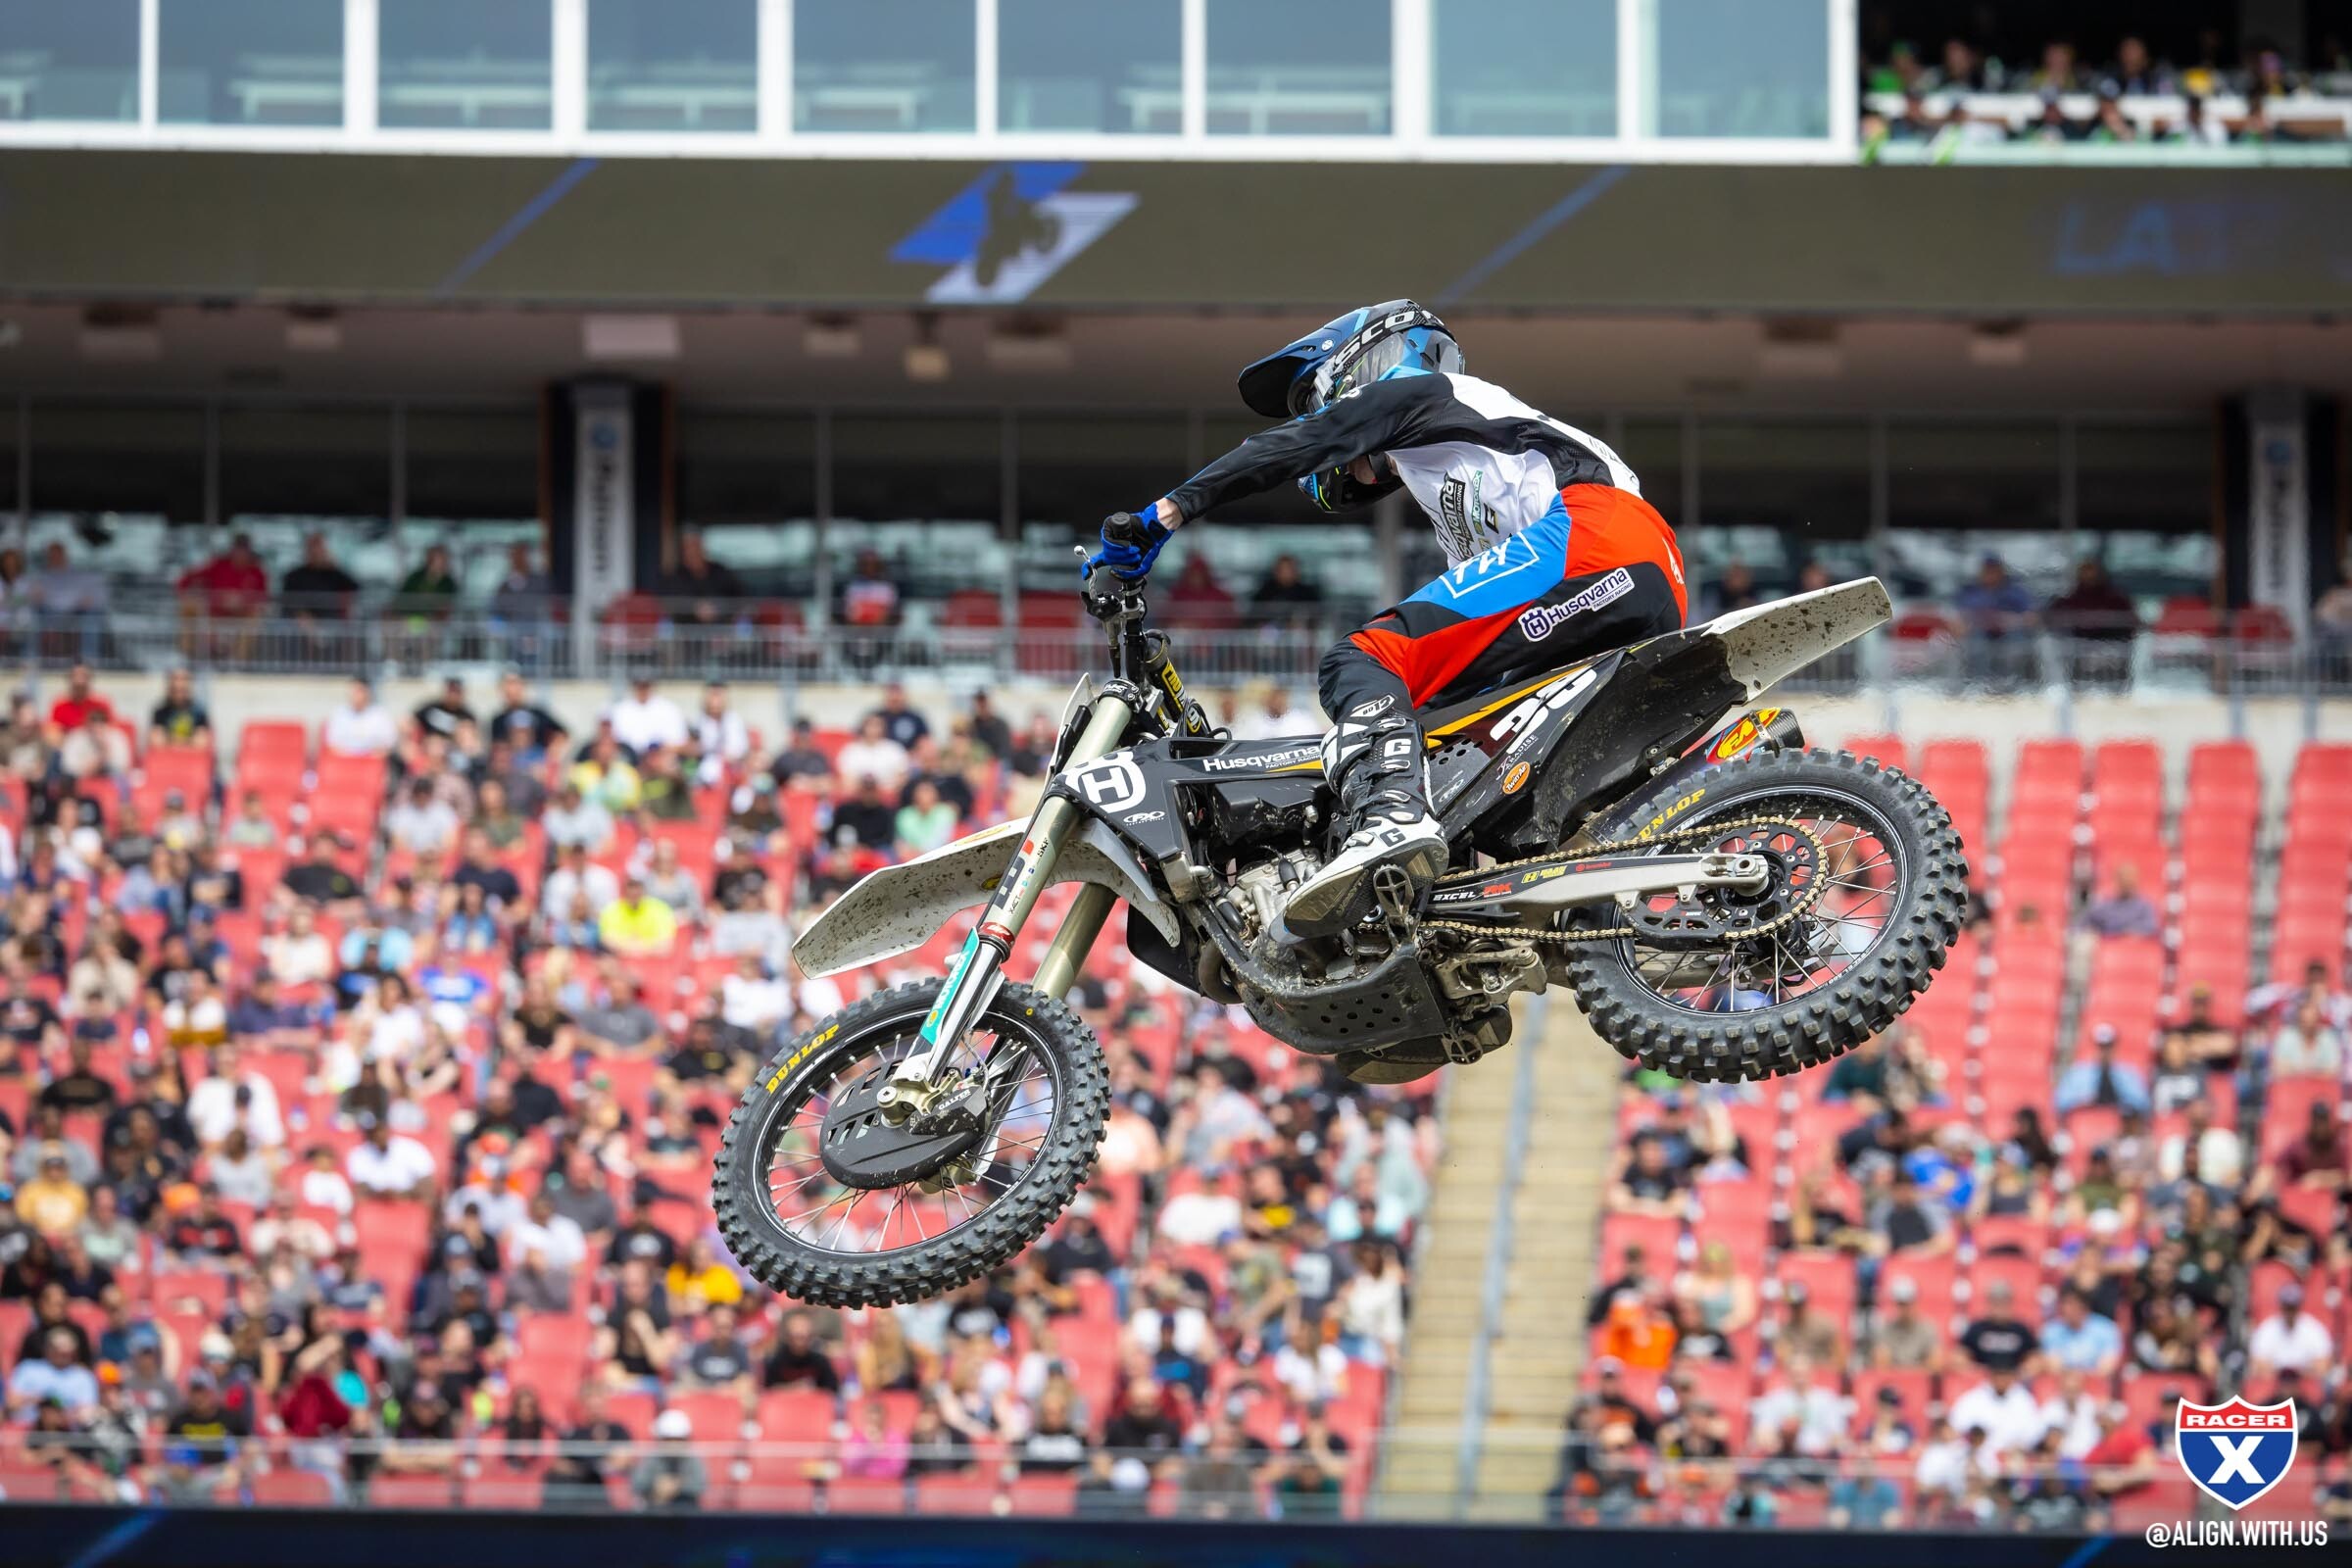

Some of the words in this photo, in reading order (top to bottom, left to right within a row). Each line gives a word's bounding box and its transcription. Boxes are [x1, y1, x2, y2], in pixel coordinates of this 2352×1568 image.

[1452, 537, 1511, 584] FLY
[1547, 569, 1628, 624] Husqvarna
[1593, 591, 1615, 609] FACTORY
[1615, 582, 1632, 599] RACING
[1202, 746, 1320, 772] Husqvarna
[1638, 789, 1706, 840] UNLOP
[1037, 837, 1050, 858] SKF
[1433, 891, 1477, 902] EXCEL
[765, 1024, 840, 1095] DUNLOP
